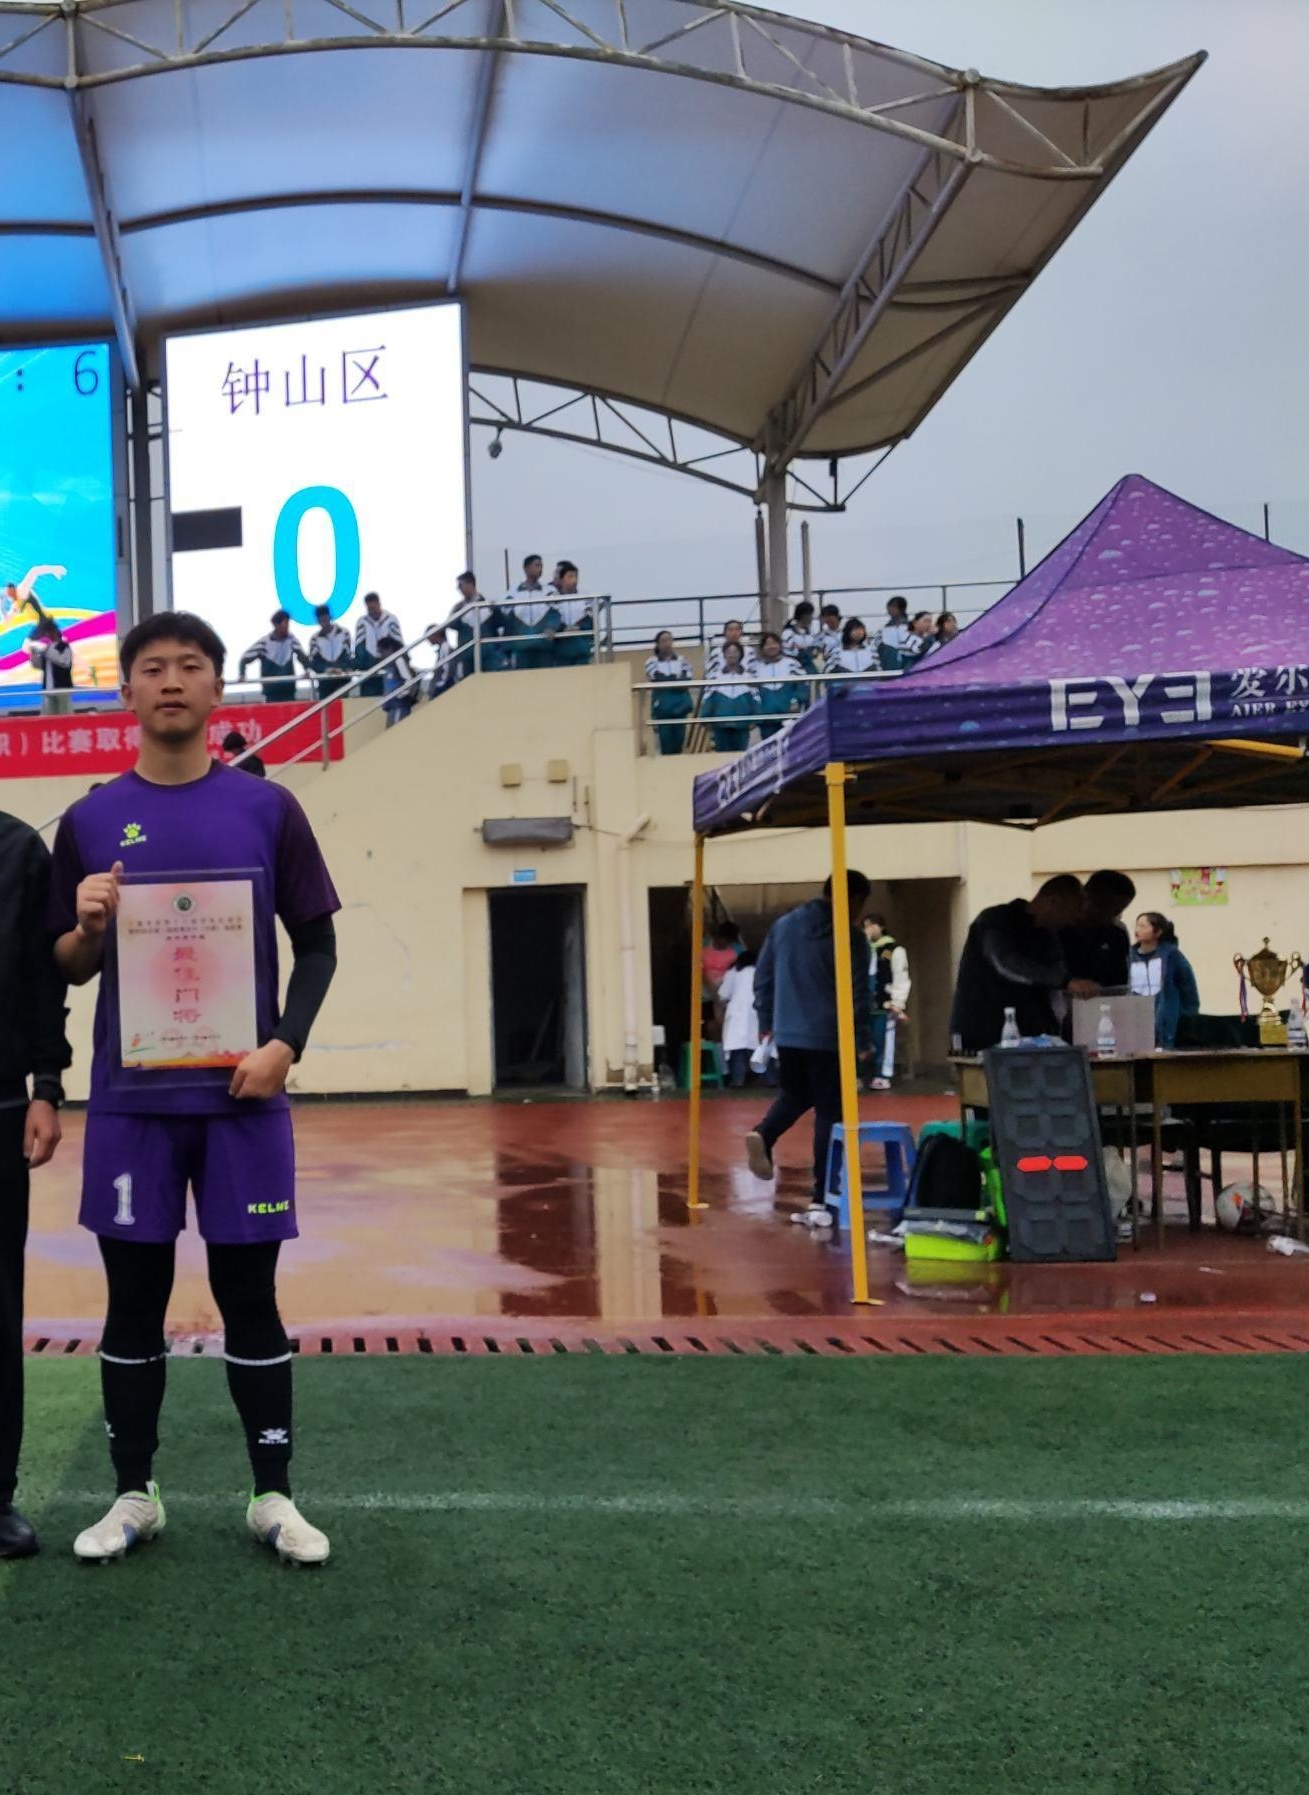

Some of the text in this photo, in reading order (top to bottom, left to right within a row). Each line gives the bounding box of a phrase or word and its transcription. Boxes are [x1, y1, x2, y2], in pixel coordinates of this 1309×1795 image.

[74, 350, 99, 395] 6
[221, 345, 388, 415] 钟山区
[273, 485, 360, 626] 0
[1231, 664, 1309, 698] 爱尔
[113, 1172, 135, 1225] 1
